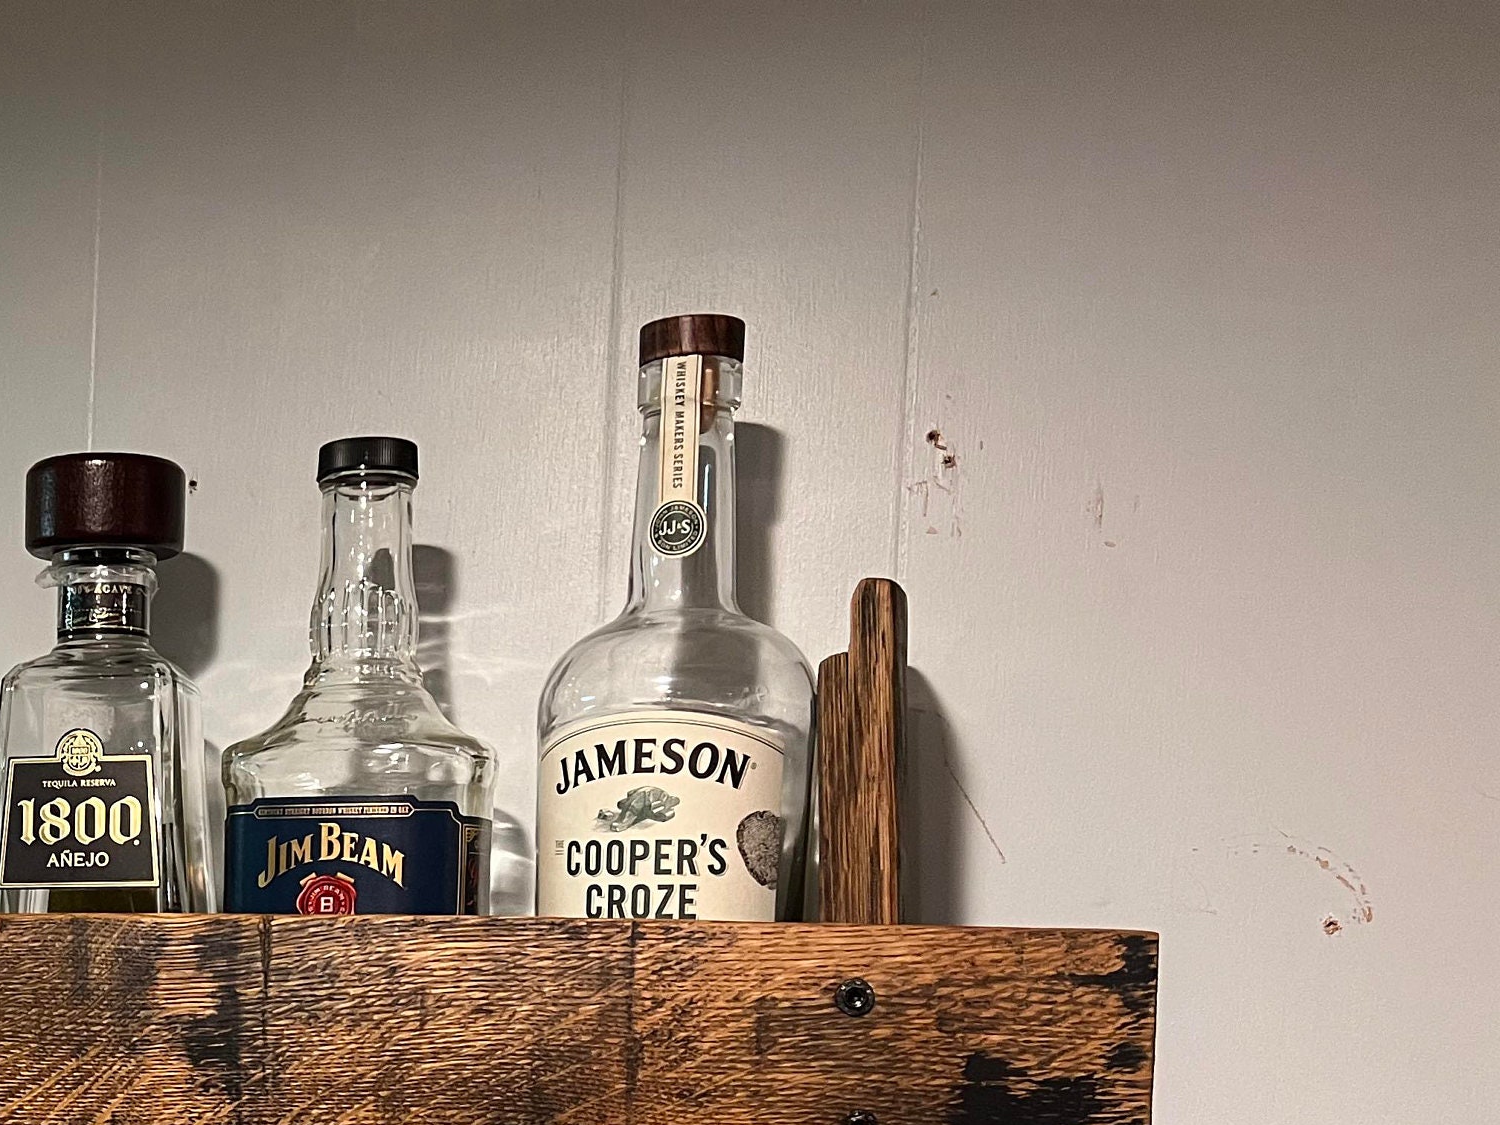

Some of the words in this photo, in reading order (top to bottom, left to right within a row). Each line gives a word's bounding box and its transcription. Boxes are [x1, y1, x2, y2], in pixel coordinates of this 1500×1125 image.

[674, 361, 687, 407] WHISKEY
[673, 411, 685, 451] MAKERS
[672, 453, 684, 489] SERIES
[658, 519, 691, 536] JJ&S
[42, 779, 78, 790] TEQUILA
[80, 778, 117, 787] RESERVA
[556, 738, 751, 795] JAMESON
[17, 795, 143, 846] 1800
[46, 850, 110, 868] AÑEJO
[566, 834, 728, 876] COOPER'S
[320, 896, 334, 912] B
[586, 883, 697, 919] CROZE
